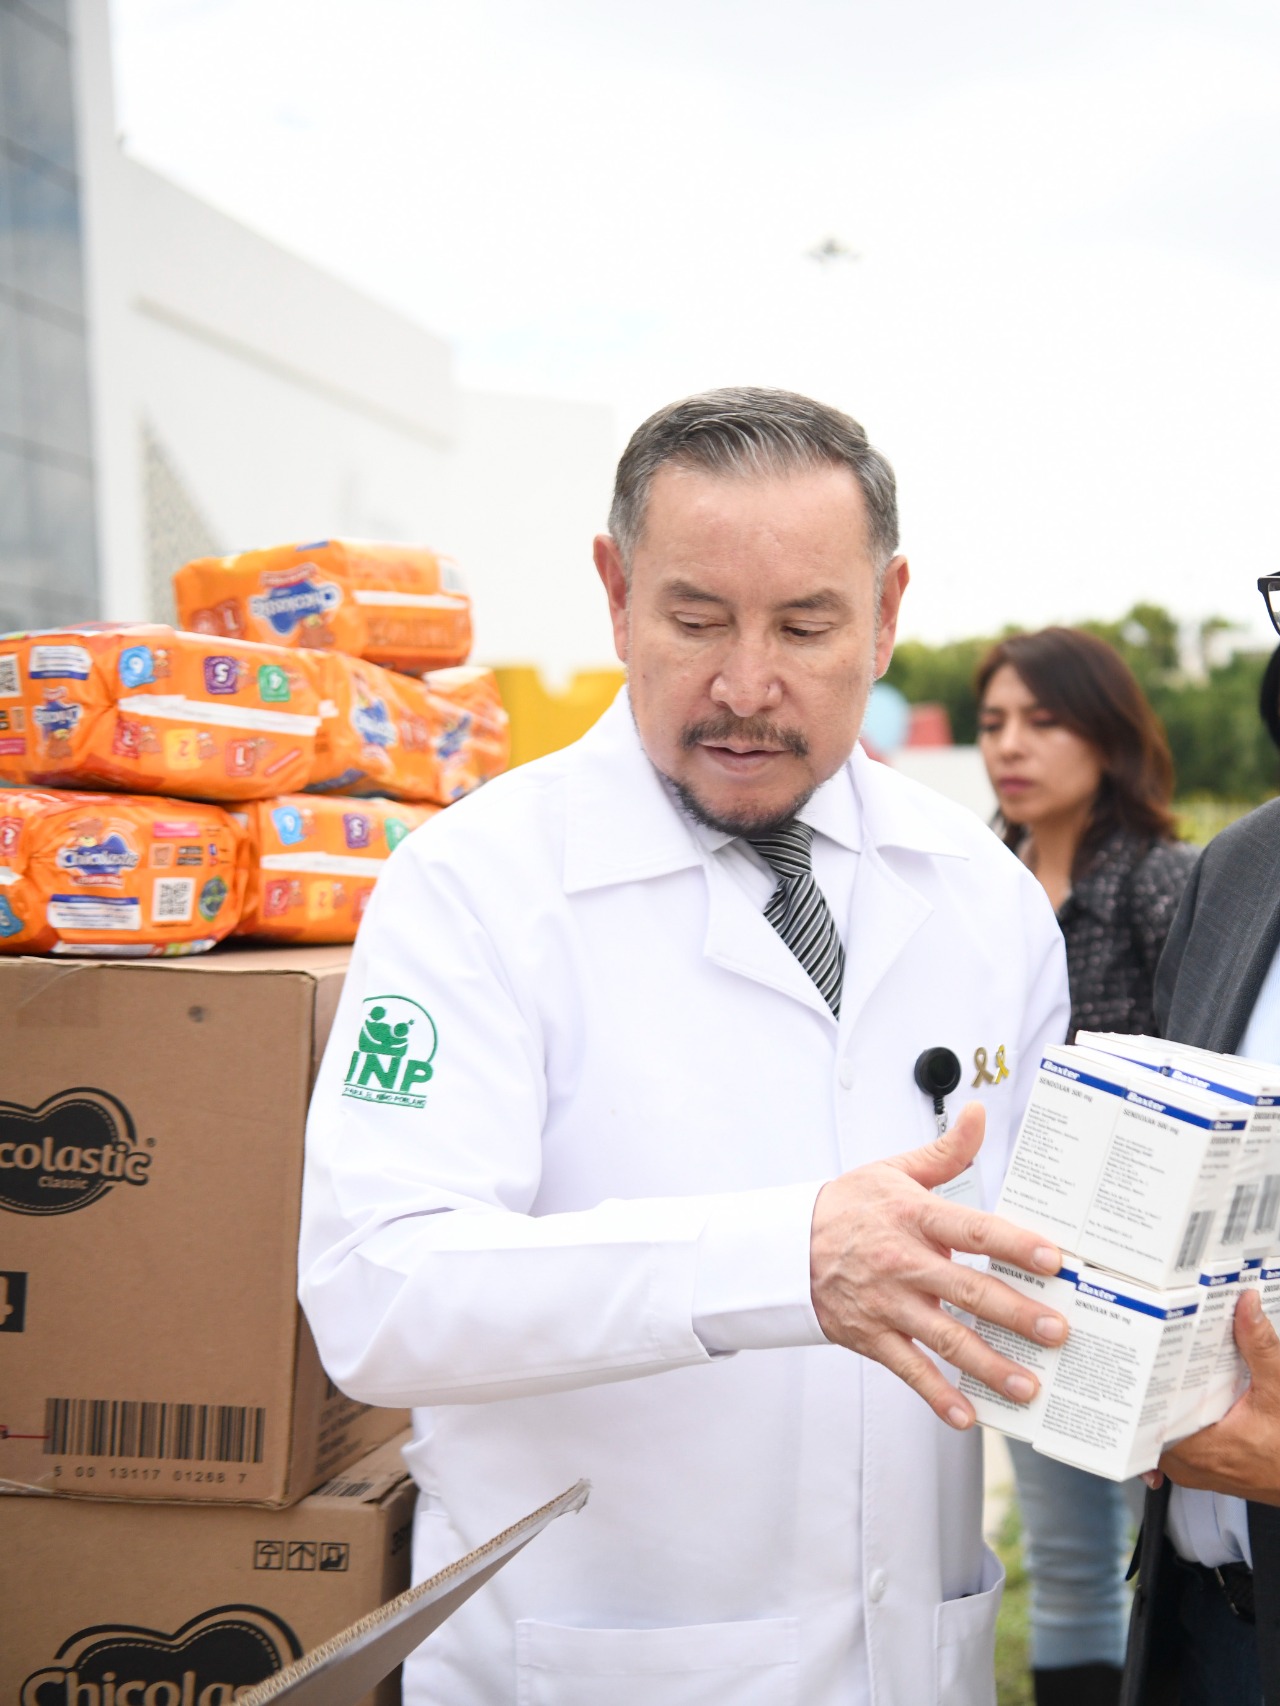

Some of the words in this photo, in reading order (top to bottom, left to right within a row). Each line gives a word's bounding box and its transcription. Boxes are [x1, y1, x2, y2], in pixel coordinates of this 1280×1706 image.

[214, 663, 230, 684] 5
[270, 673, 282, 691] 4
[344, 1050, 434, 1094] INP
[1042, 1059, 1081, 1081] Baxter
[1126, 1091, 1167, 1113] Baxter
[37, 1175, 90, 1190] Classic
[990, 1262, 1023, 1281] SENDOXAN
[1023, 1274, 1035, 1285] 500
[1077, 1280, 1117, 1302] Baxter
[54, 1465, 63, 1478] 5
[75, 1465, 96, 1479] 00
[109, 1467, 161, 1480] 13117
[239, 1473, 248, 1484] 7
